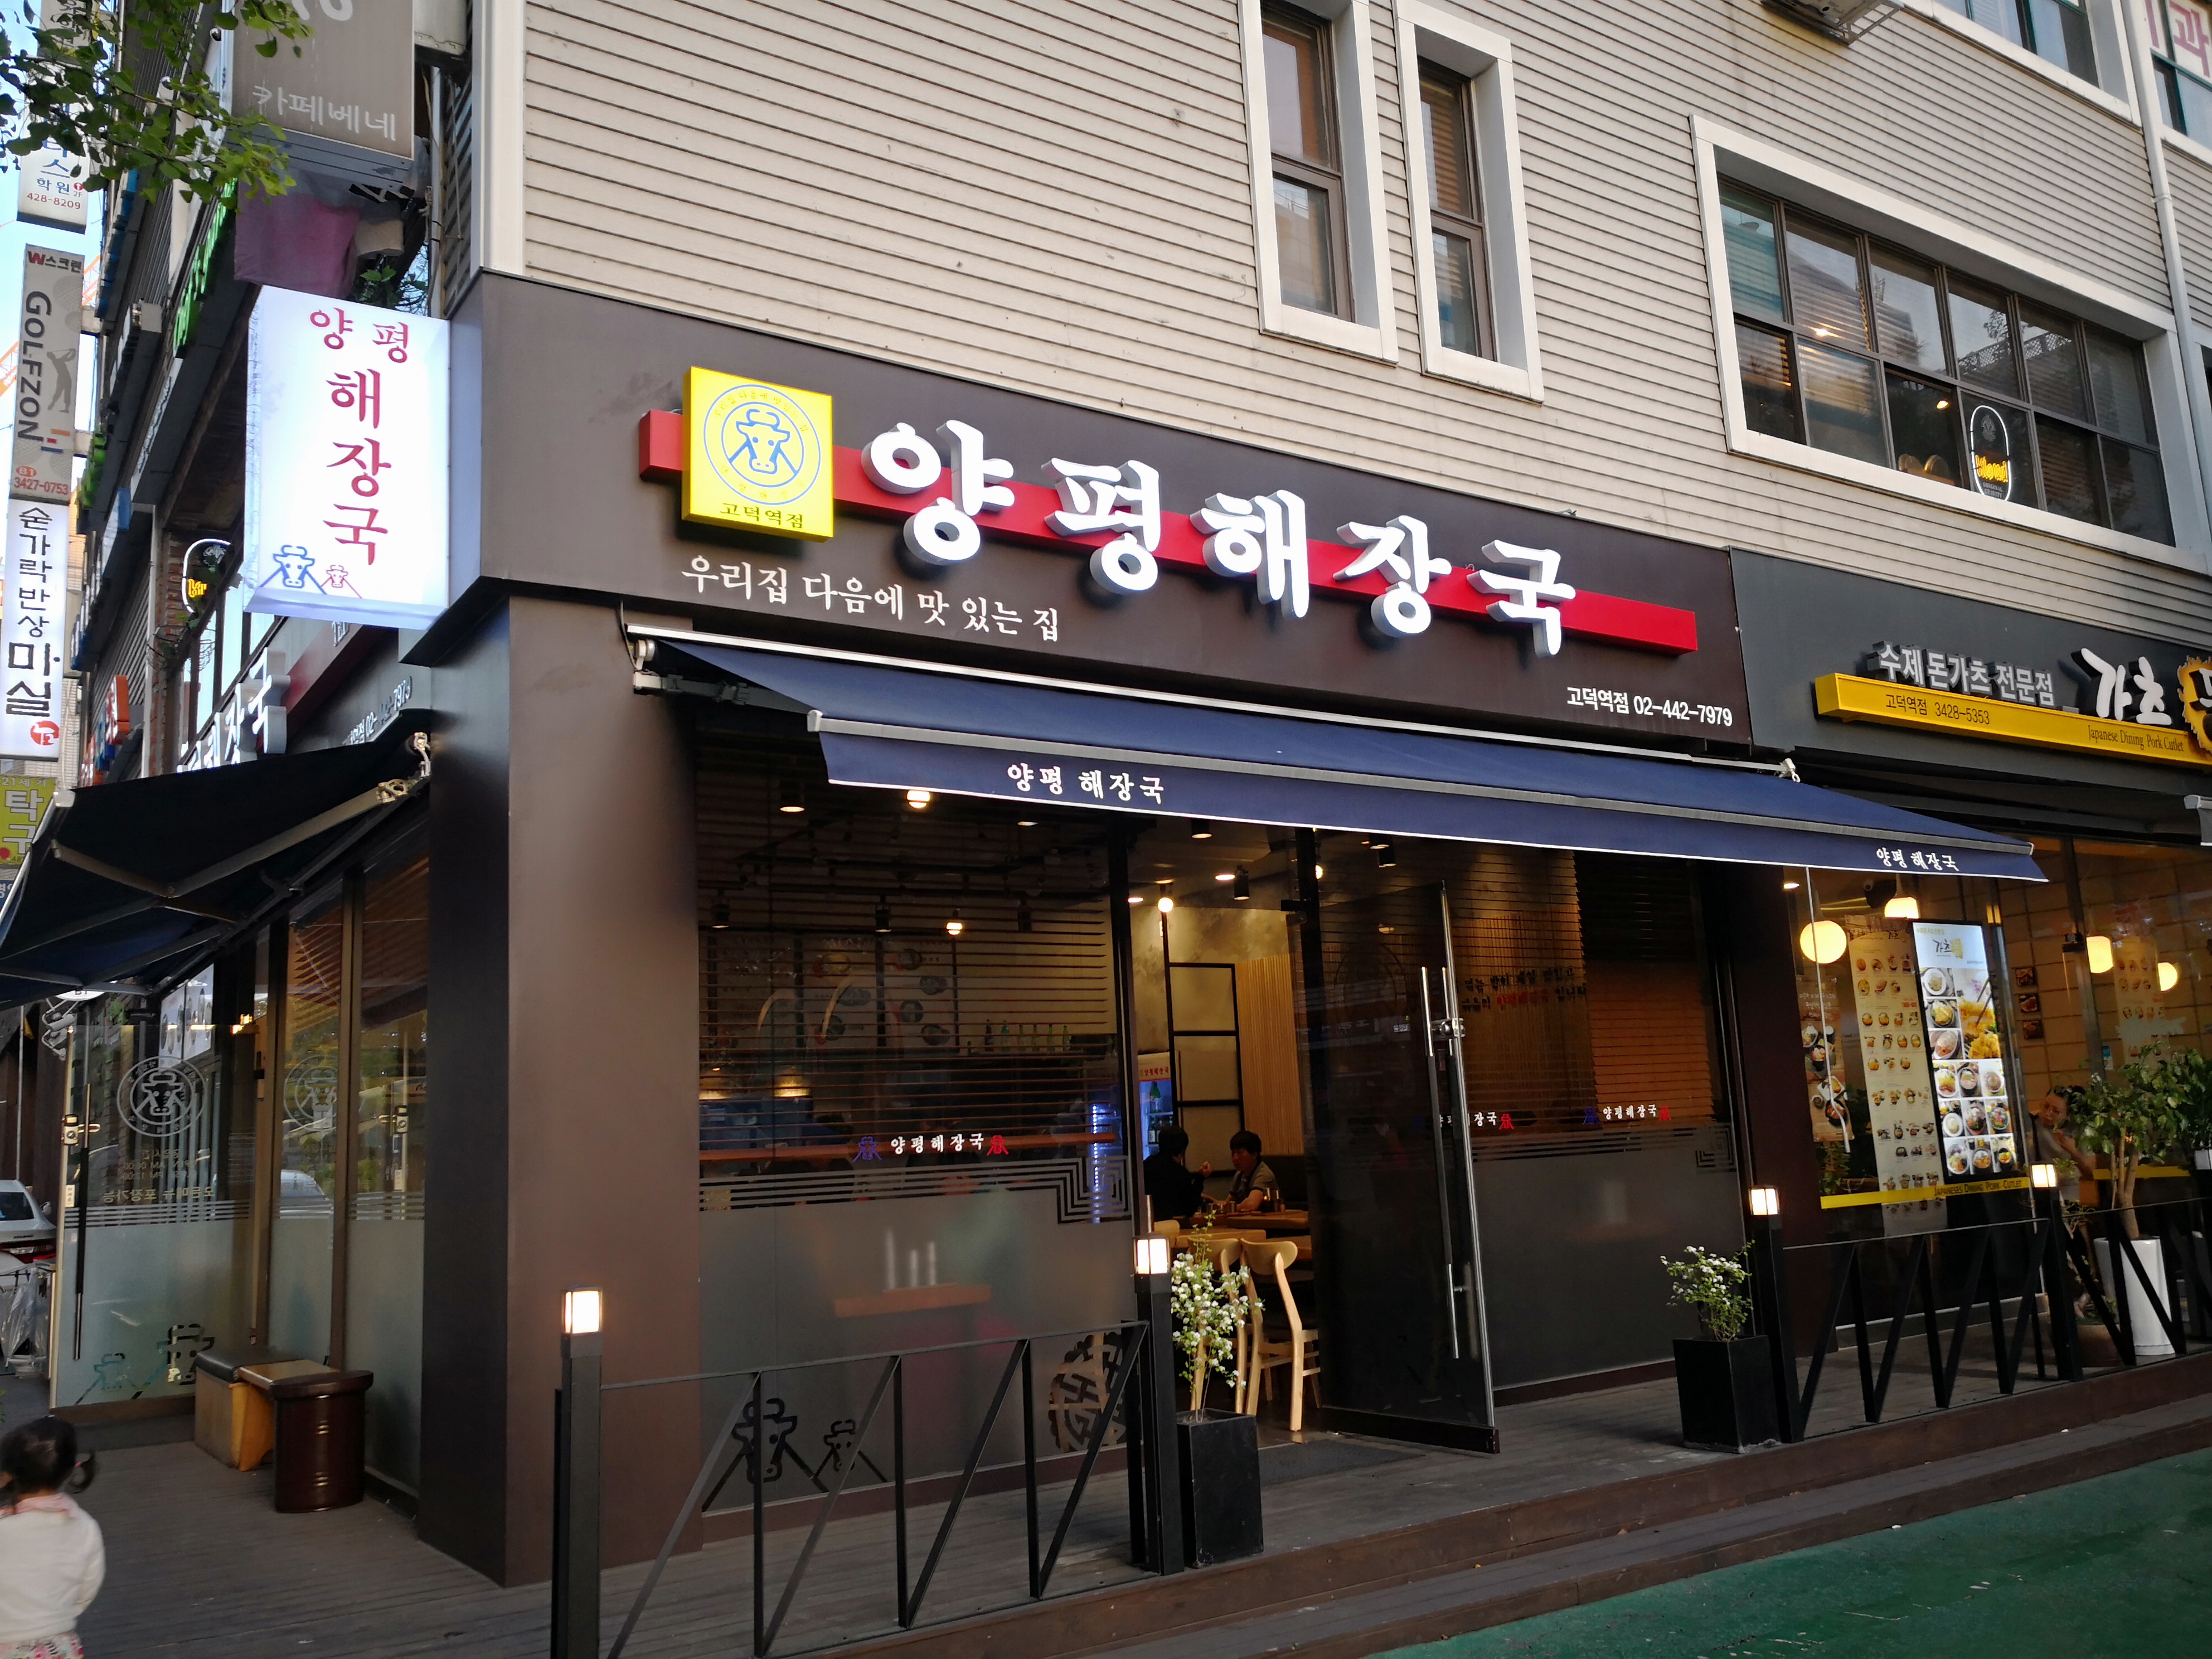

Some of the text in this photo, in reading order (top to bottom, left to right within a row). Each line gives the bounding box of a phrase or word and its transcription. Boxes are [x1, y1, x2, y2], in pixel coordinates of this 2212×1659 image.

[253, 85, 396, 141] 카페베네
[27, 192, 81, 209] 428-8209
[36, 177, 70, 195] 학원
[310, 307, 409, 363] 양평
[17, 290, 52, 442] GOLFZON
[14, 477, 68, 494] 3427-0753
[18, 466, 35, 477] B1
[323, 368, 391, 565] 해장국
[720, 502, 803, 528] 고덕역점
[861, 420, 1576, 657] 양평해장국
[18, 507, 53, 638] 숟가락반상
[682, 555, 787, 604] 우리집
[802, 573, 903, 621] 다음에
[1032, 608, 1058, 642] 집
[6, 642, 51, 717] 미실
[1996, 664, 2055, 706] 전문점
[2081, 648, 2212, 725] 가츠
[1567, 687, 1733, 726] 고덕역점 02-442-7979
[1886, 694, 1990, 725] 고덕역점 3428-5353
[2088, 725, 2184, 751] Japanese Dining Pork Cutlet
[1007, 763, 1164, 804] 양평 해장국
[3, 789, 43, 854] 탁구
[1876, 847, 1959, 871] 양평 해장국
[1603, 1104, 1657, 1120] 양평해장국
[891, 1133, 984, 1154] 양평해장국
